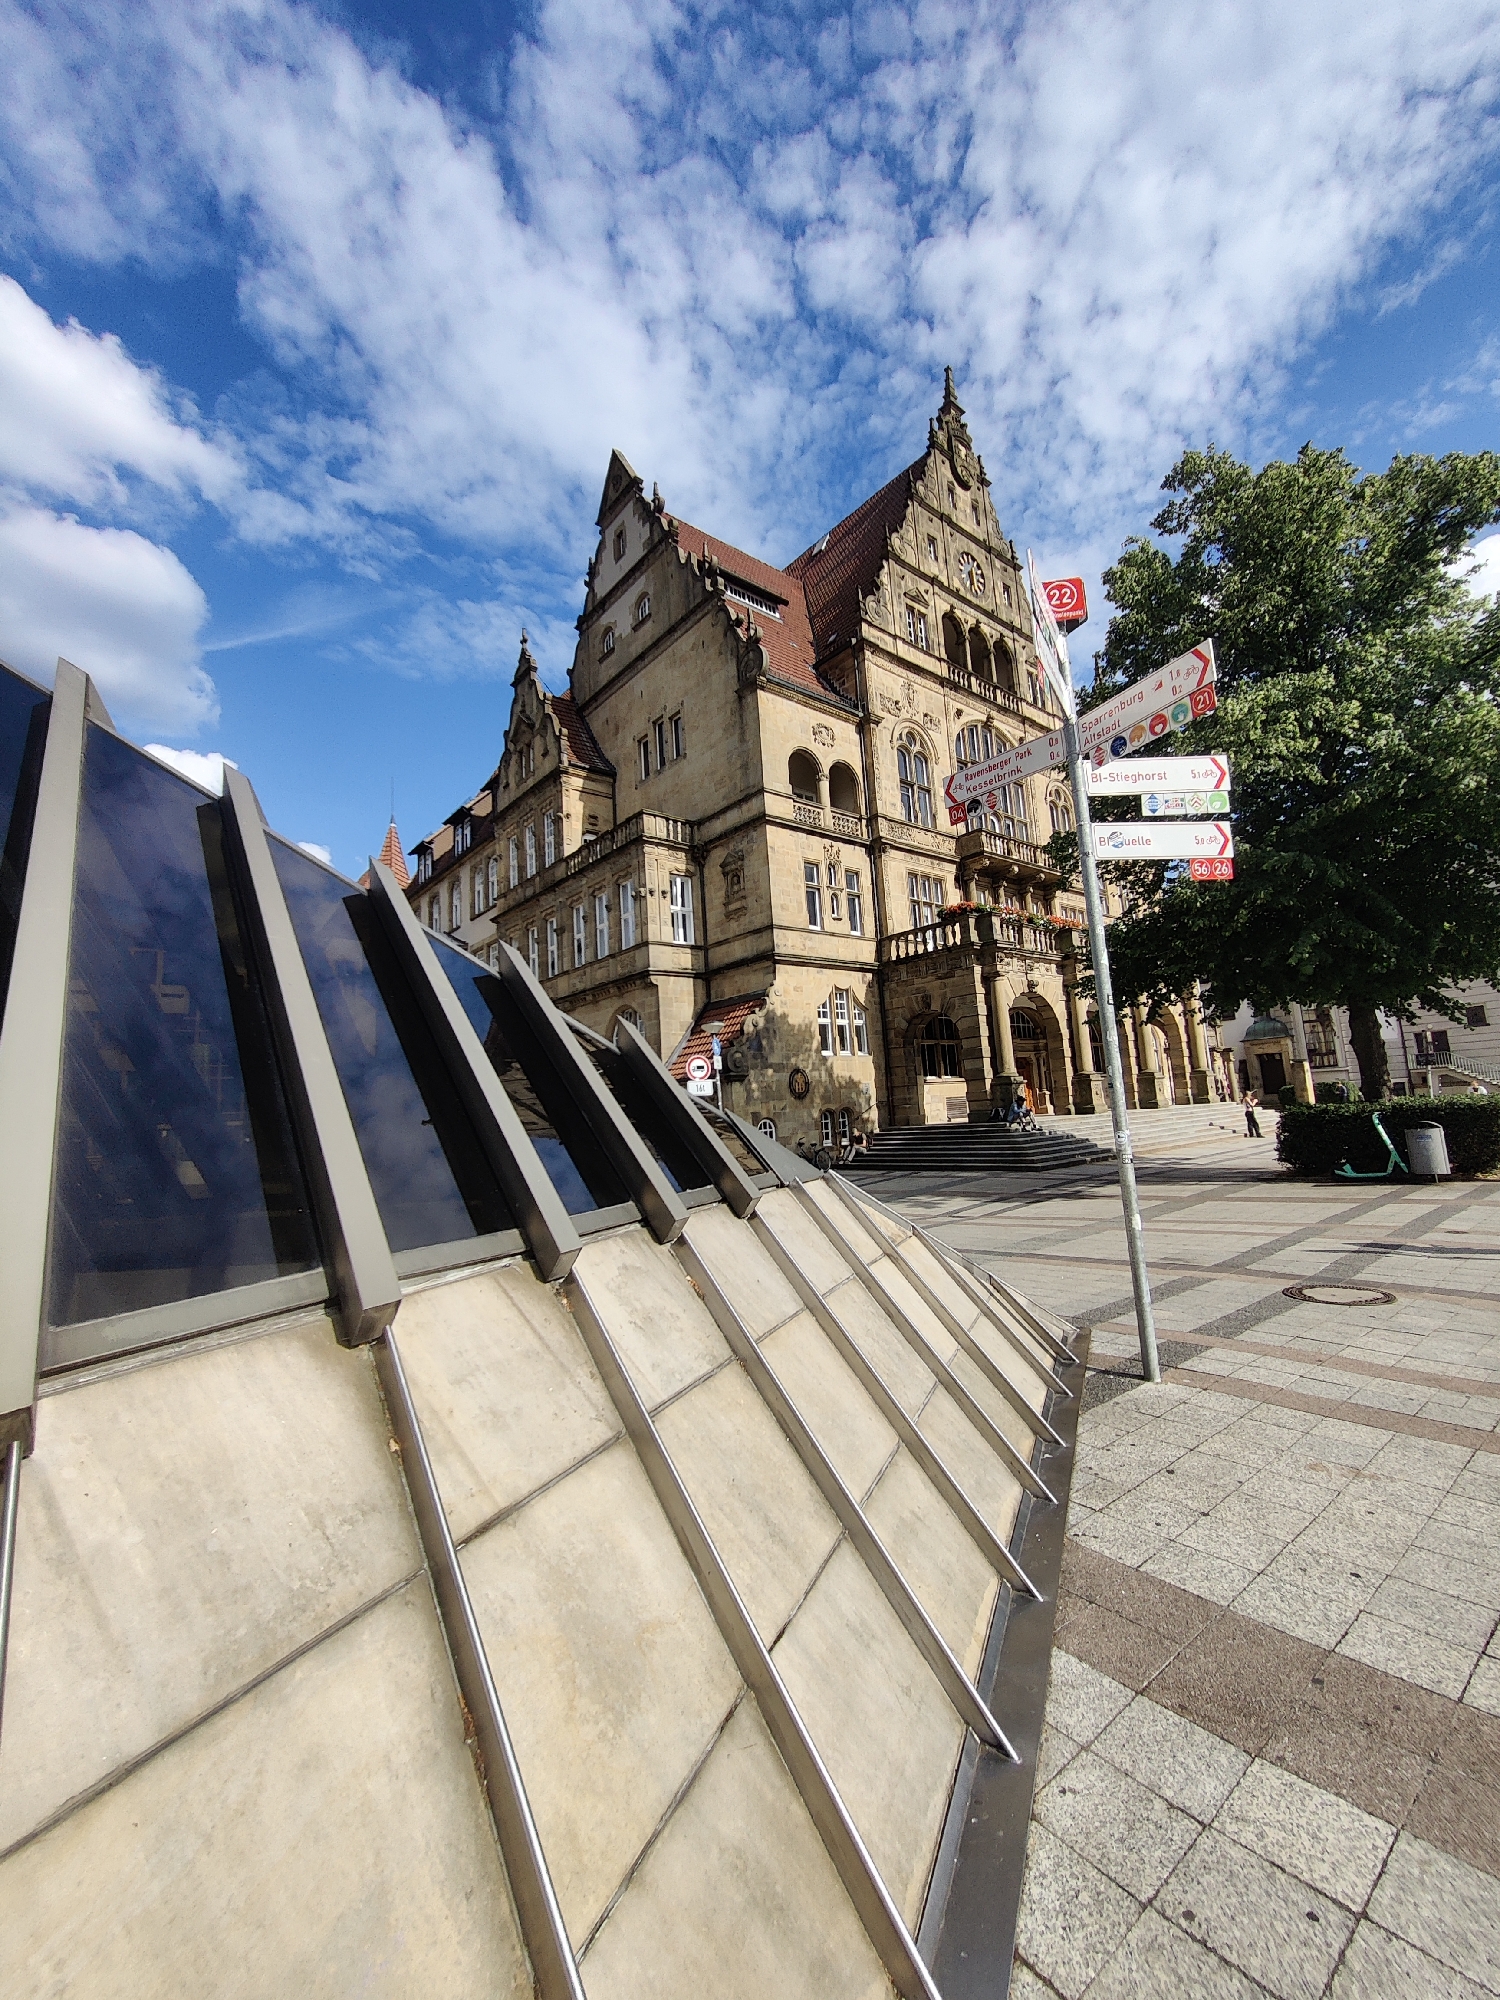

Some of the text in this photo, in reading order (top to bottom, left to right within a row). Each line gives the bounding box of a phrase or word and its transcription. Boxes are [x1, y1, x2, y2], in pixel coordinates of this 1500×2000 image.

[1049, 588, 1072, 605] 22
[1196, 692, 1211, 709] 21
[1081, 690, 1144, 733] Sparrenburg
[1083, 720, 1122, 747] Altstadt
[964, 756, 1012, 782] Ravensberger
[1015, 747, 1033, 761] Park
[965, 765, 1023, 794] Kesselbrink
[1091, 771, 1168, 783] BI-Stieghorst
[951, 810, 964, 820] 04
[1194, 864, 1228, 875] 56 26
